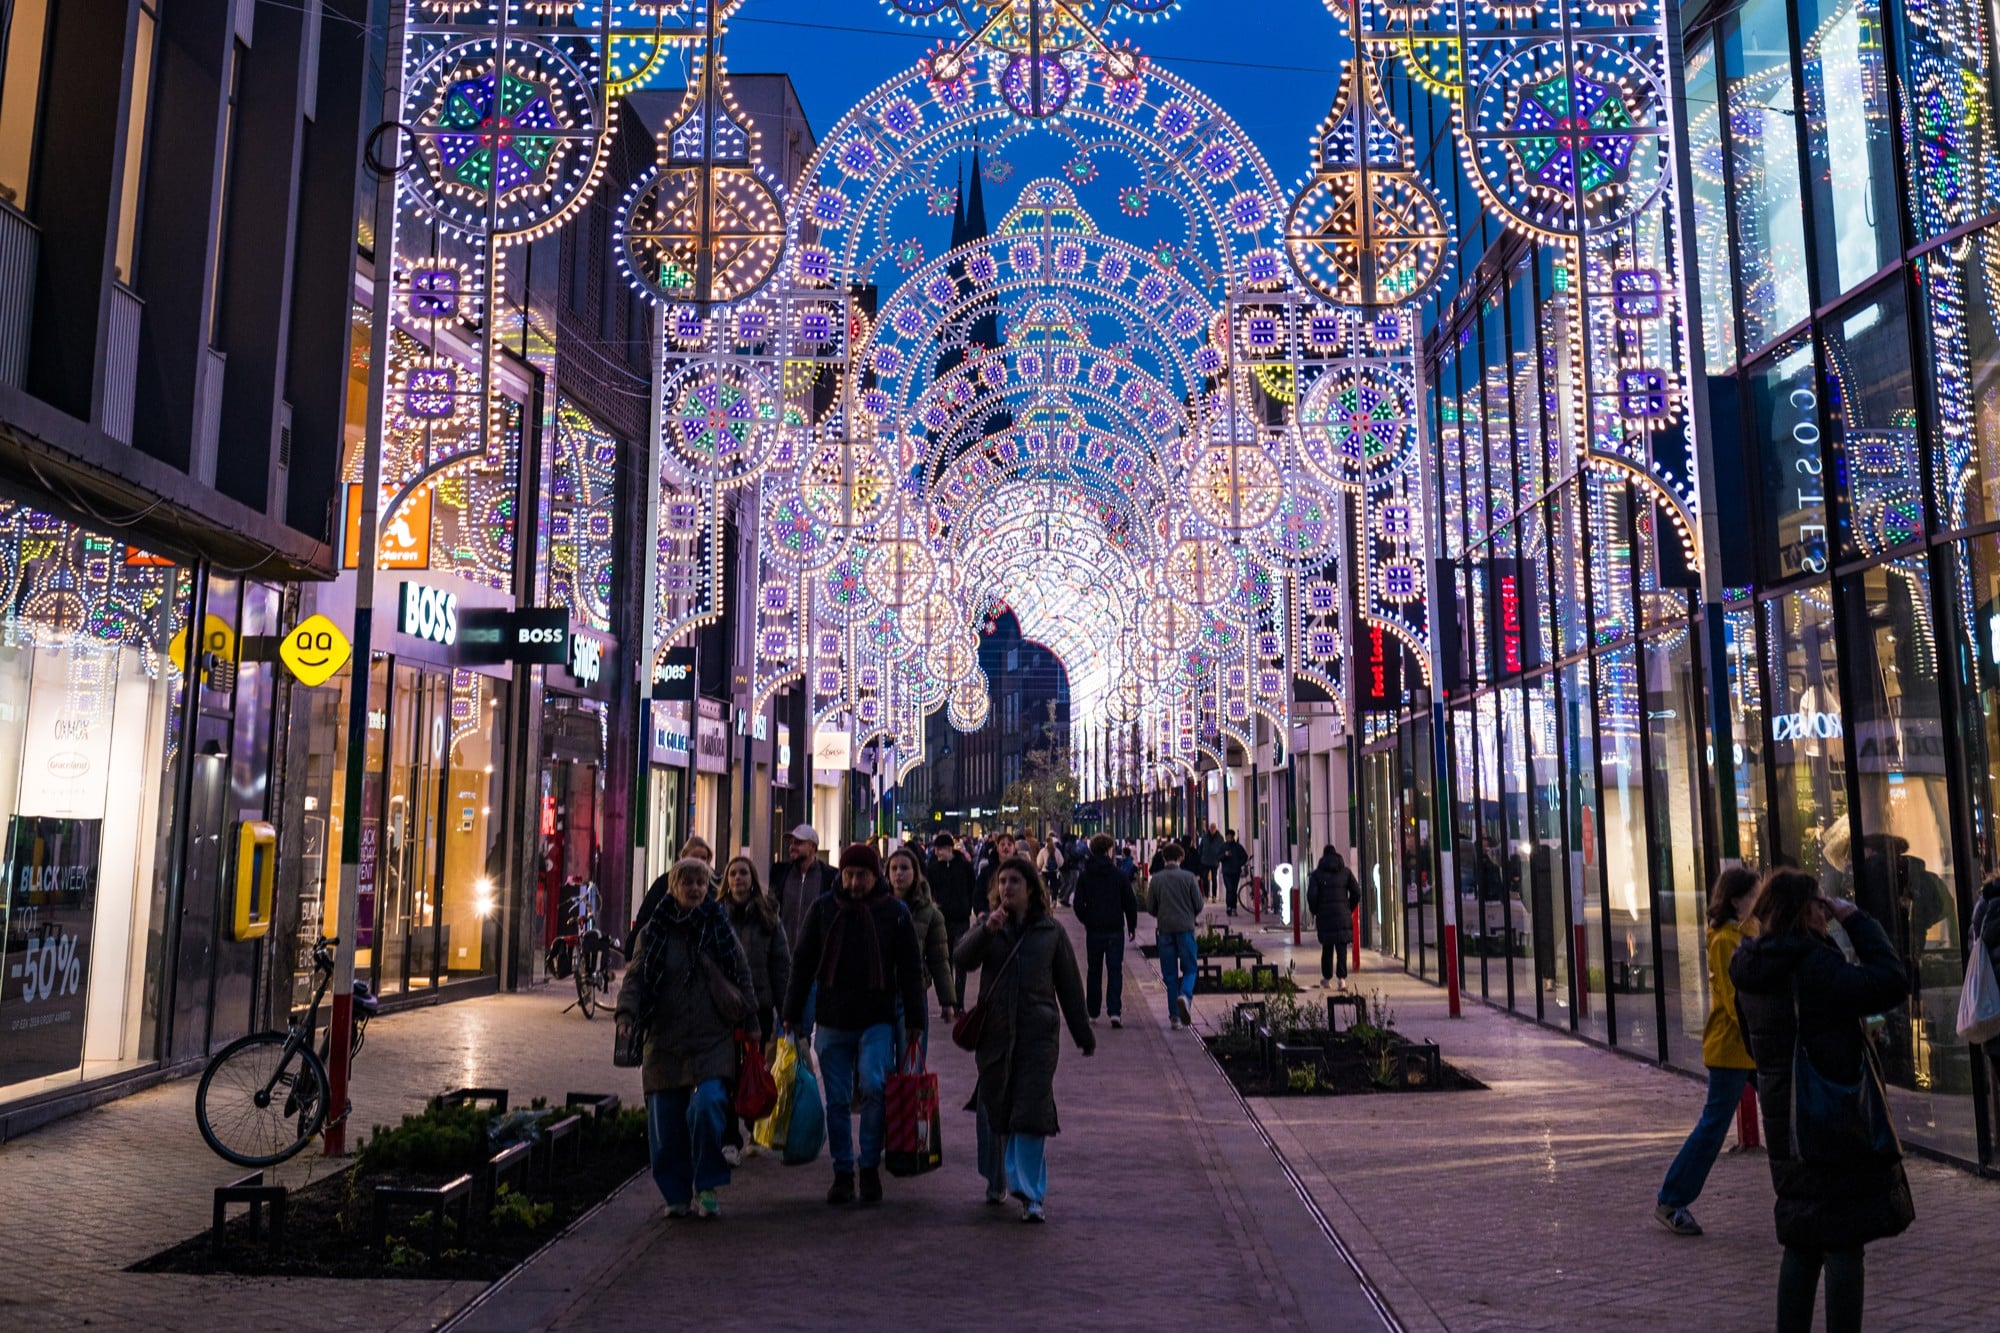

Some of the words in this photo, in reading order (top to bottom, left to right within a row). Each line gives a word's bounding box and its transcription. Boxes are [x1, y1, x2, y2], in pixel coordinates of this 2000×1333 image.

[405, 580, 457, 645] BOSS
[518, 628, 563, 643] BOSS
[21, 866, 60, 892] BLACK
[60, 864, 89, 890] WEEK
[17, 905, 38, 933] TOT
[11, 933, 81, 1004] -50%
